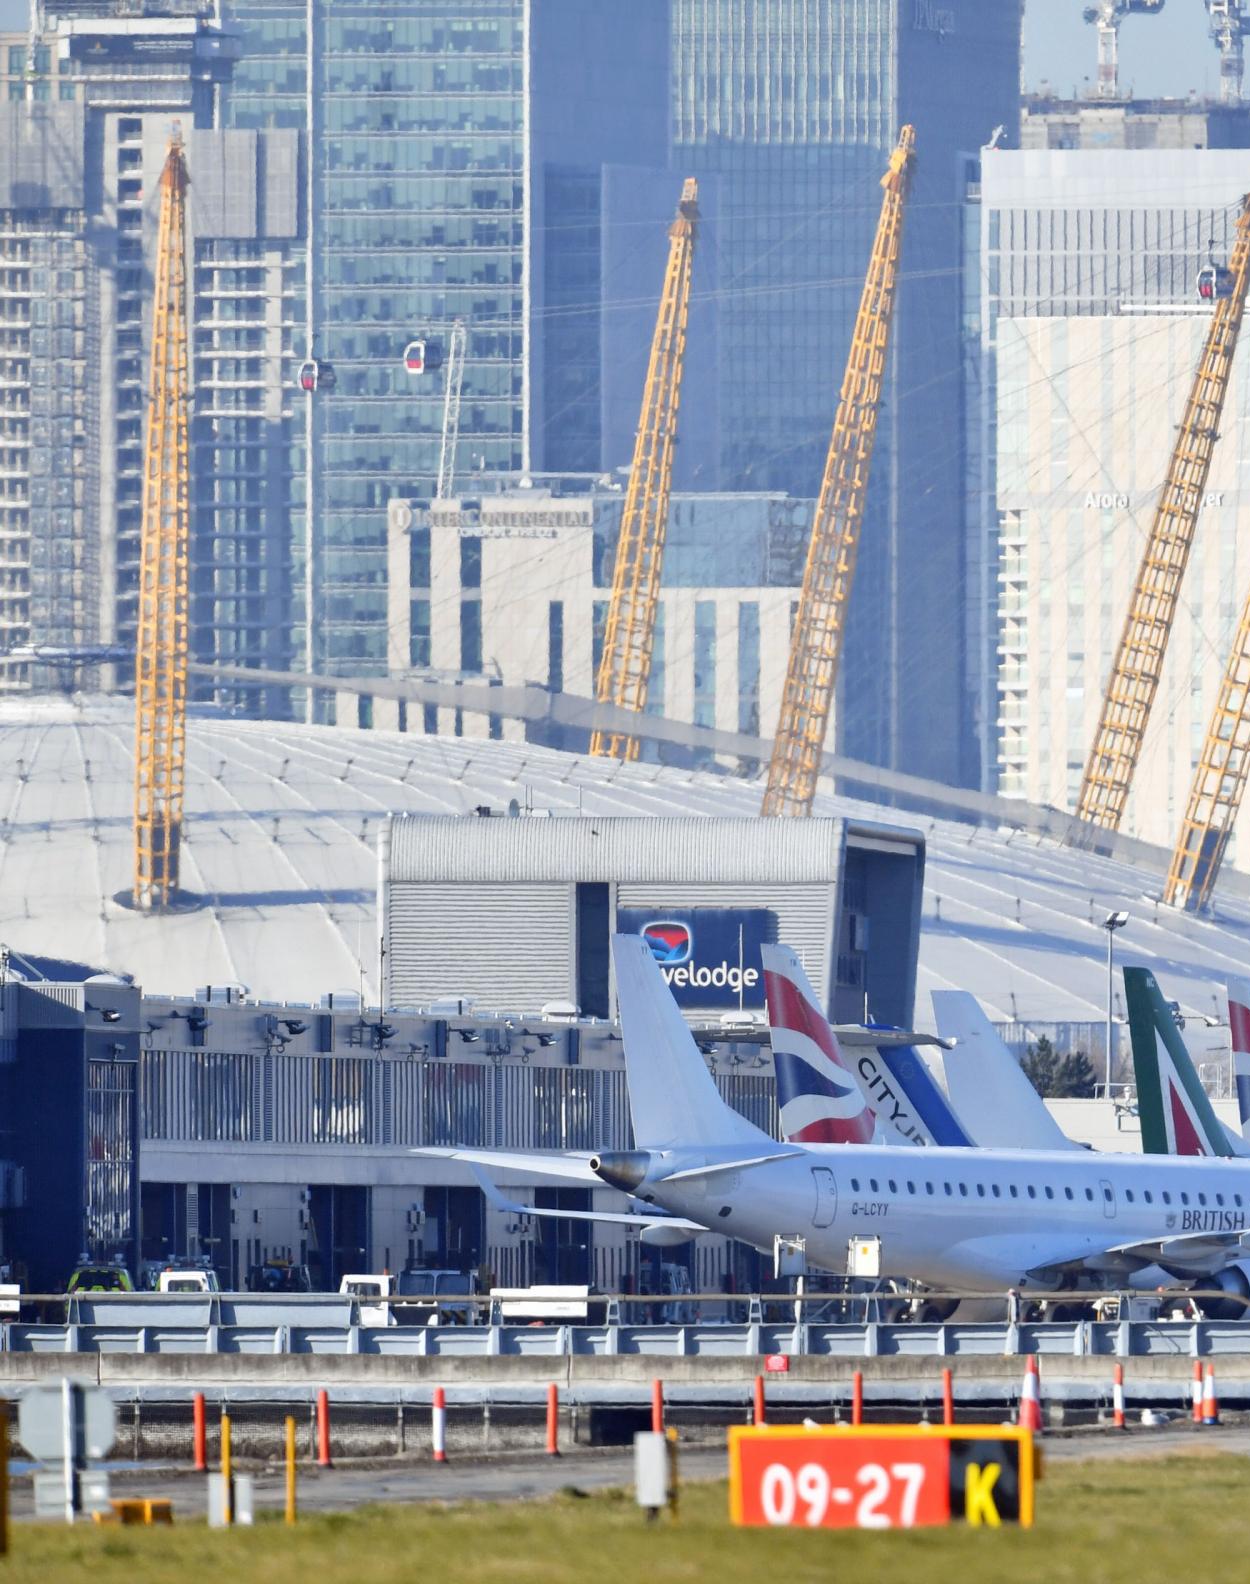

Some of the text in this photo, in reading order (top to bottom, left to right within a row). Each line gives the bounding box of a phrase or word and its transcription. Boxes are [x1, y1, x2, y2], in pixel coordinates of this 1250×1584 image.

[1084, 491, 1130, 509] Arora
[661, 960, 758, 993] velodge
[852, 1202, 889, 1216] G-LCYY
[1182, 1210, 1244, 1231] BRITISH
[761, 1462, 1001, 1528] 09-27 K
